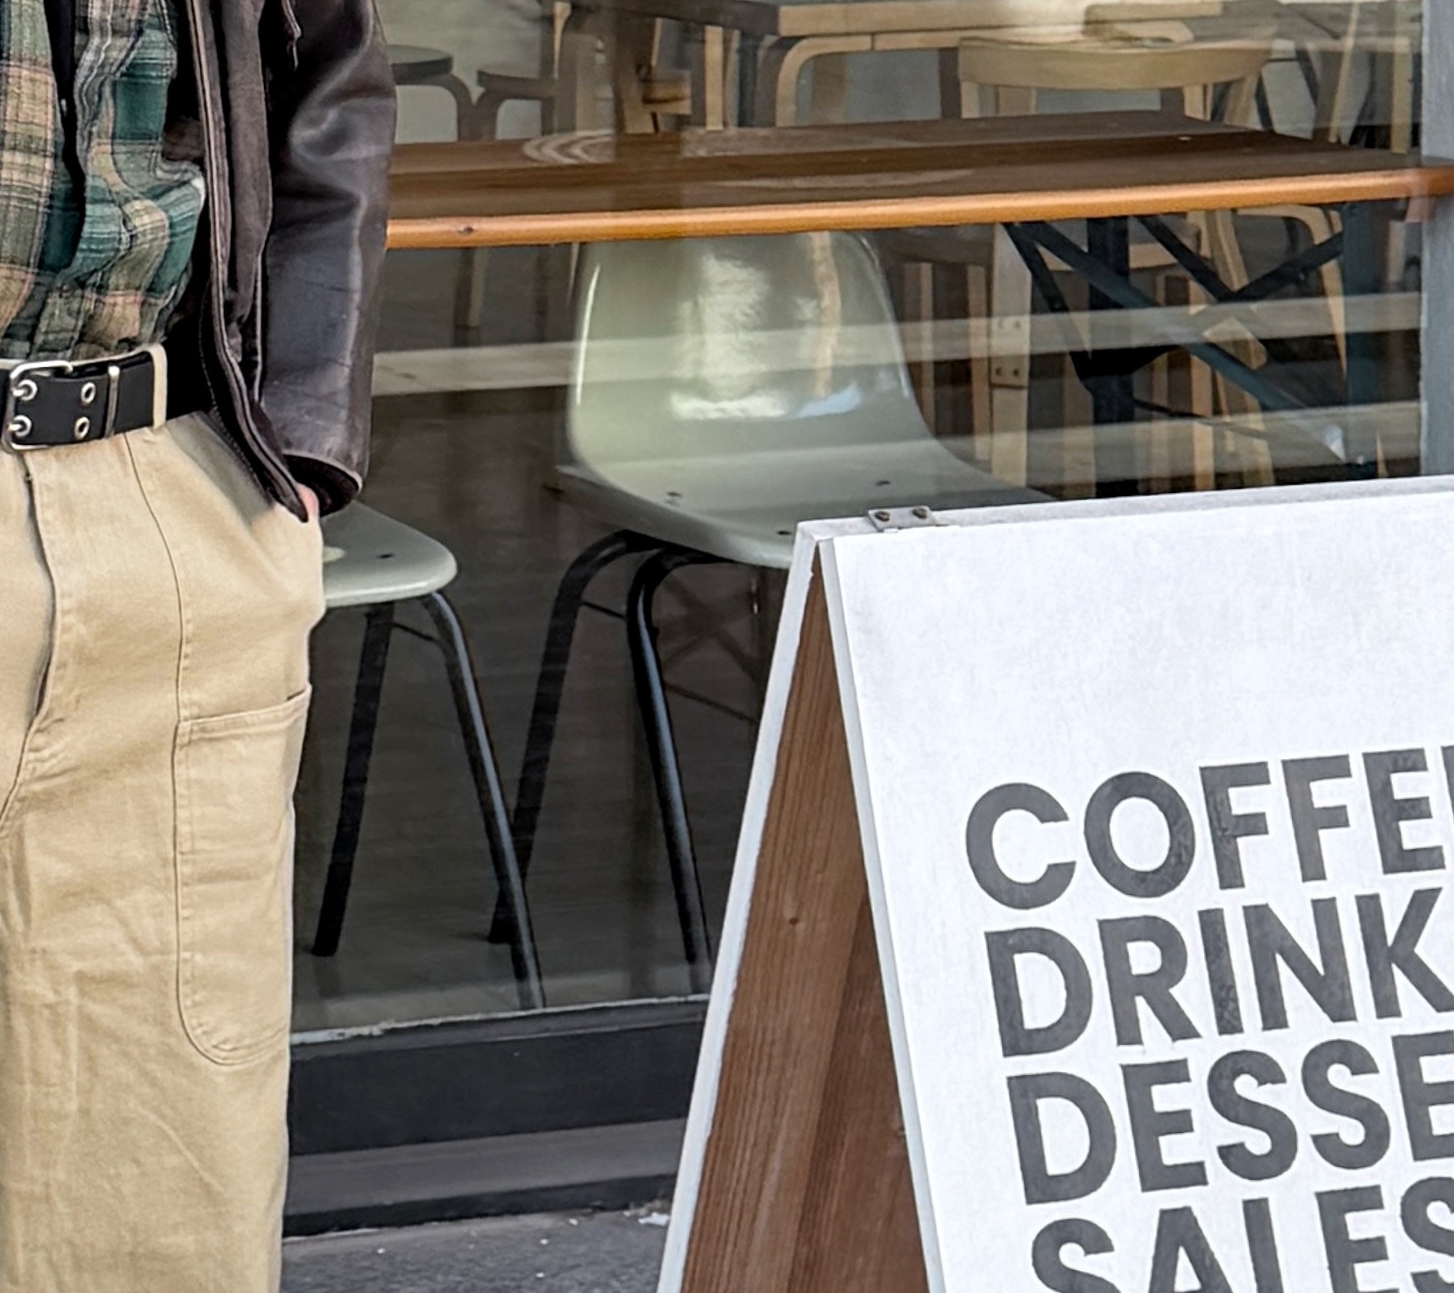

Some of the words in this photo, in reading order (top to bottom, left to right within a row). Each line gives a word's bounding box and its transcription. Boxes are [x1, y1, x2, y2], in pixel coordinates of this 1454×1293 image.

[965, 745, 1454, 910] COFFE
[984, 887, 1454, 1058] DRINK
[1006, 1029, 1454, 1205] DESSE
